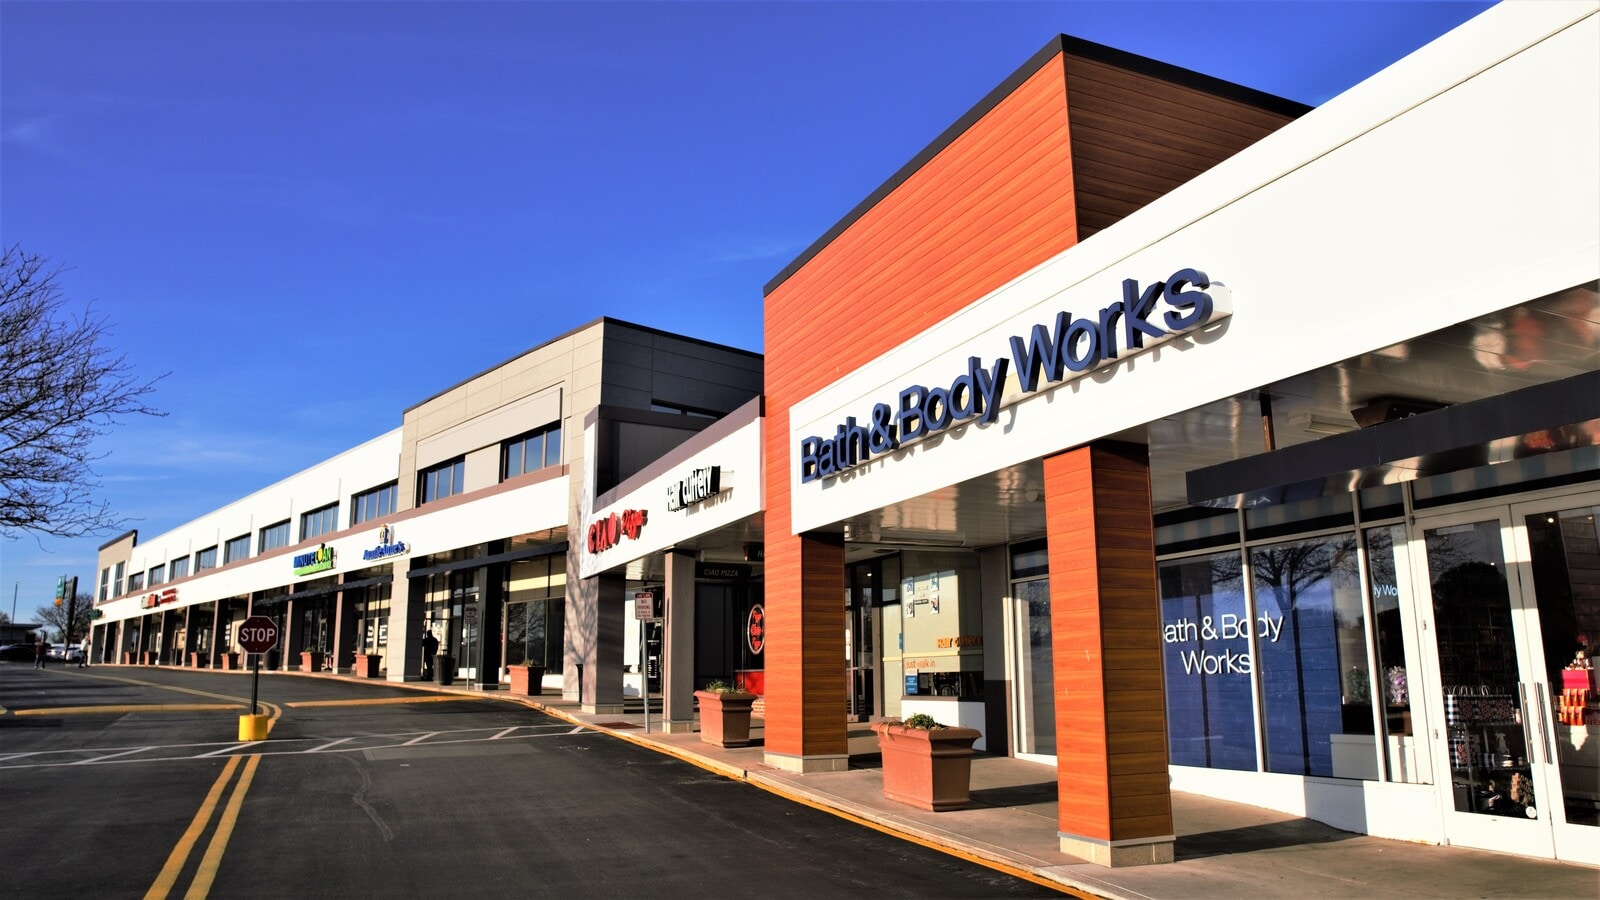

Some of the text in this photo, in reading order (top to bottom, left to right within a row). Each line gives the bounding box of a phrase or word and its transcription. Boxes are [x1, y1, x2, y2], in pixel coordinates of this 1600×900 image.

[801, 267, 1213, 484] Bath & Body Works
[587, 511, 620, 554] CIAO
[703, 568, 739, 577] CIAO PIZZA
[240, 627, 275, 642] STOP
[1163, 610, 1284, 643] ath & Body
[1180, 648, 1251, 675] Works
